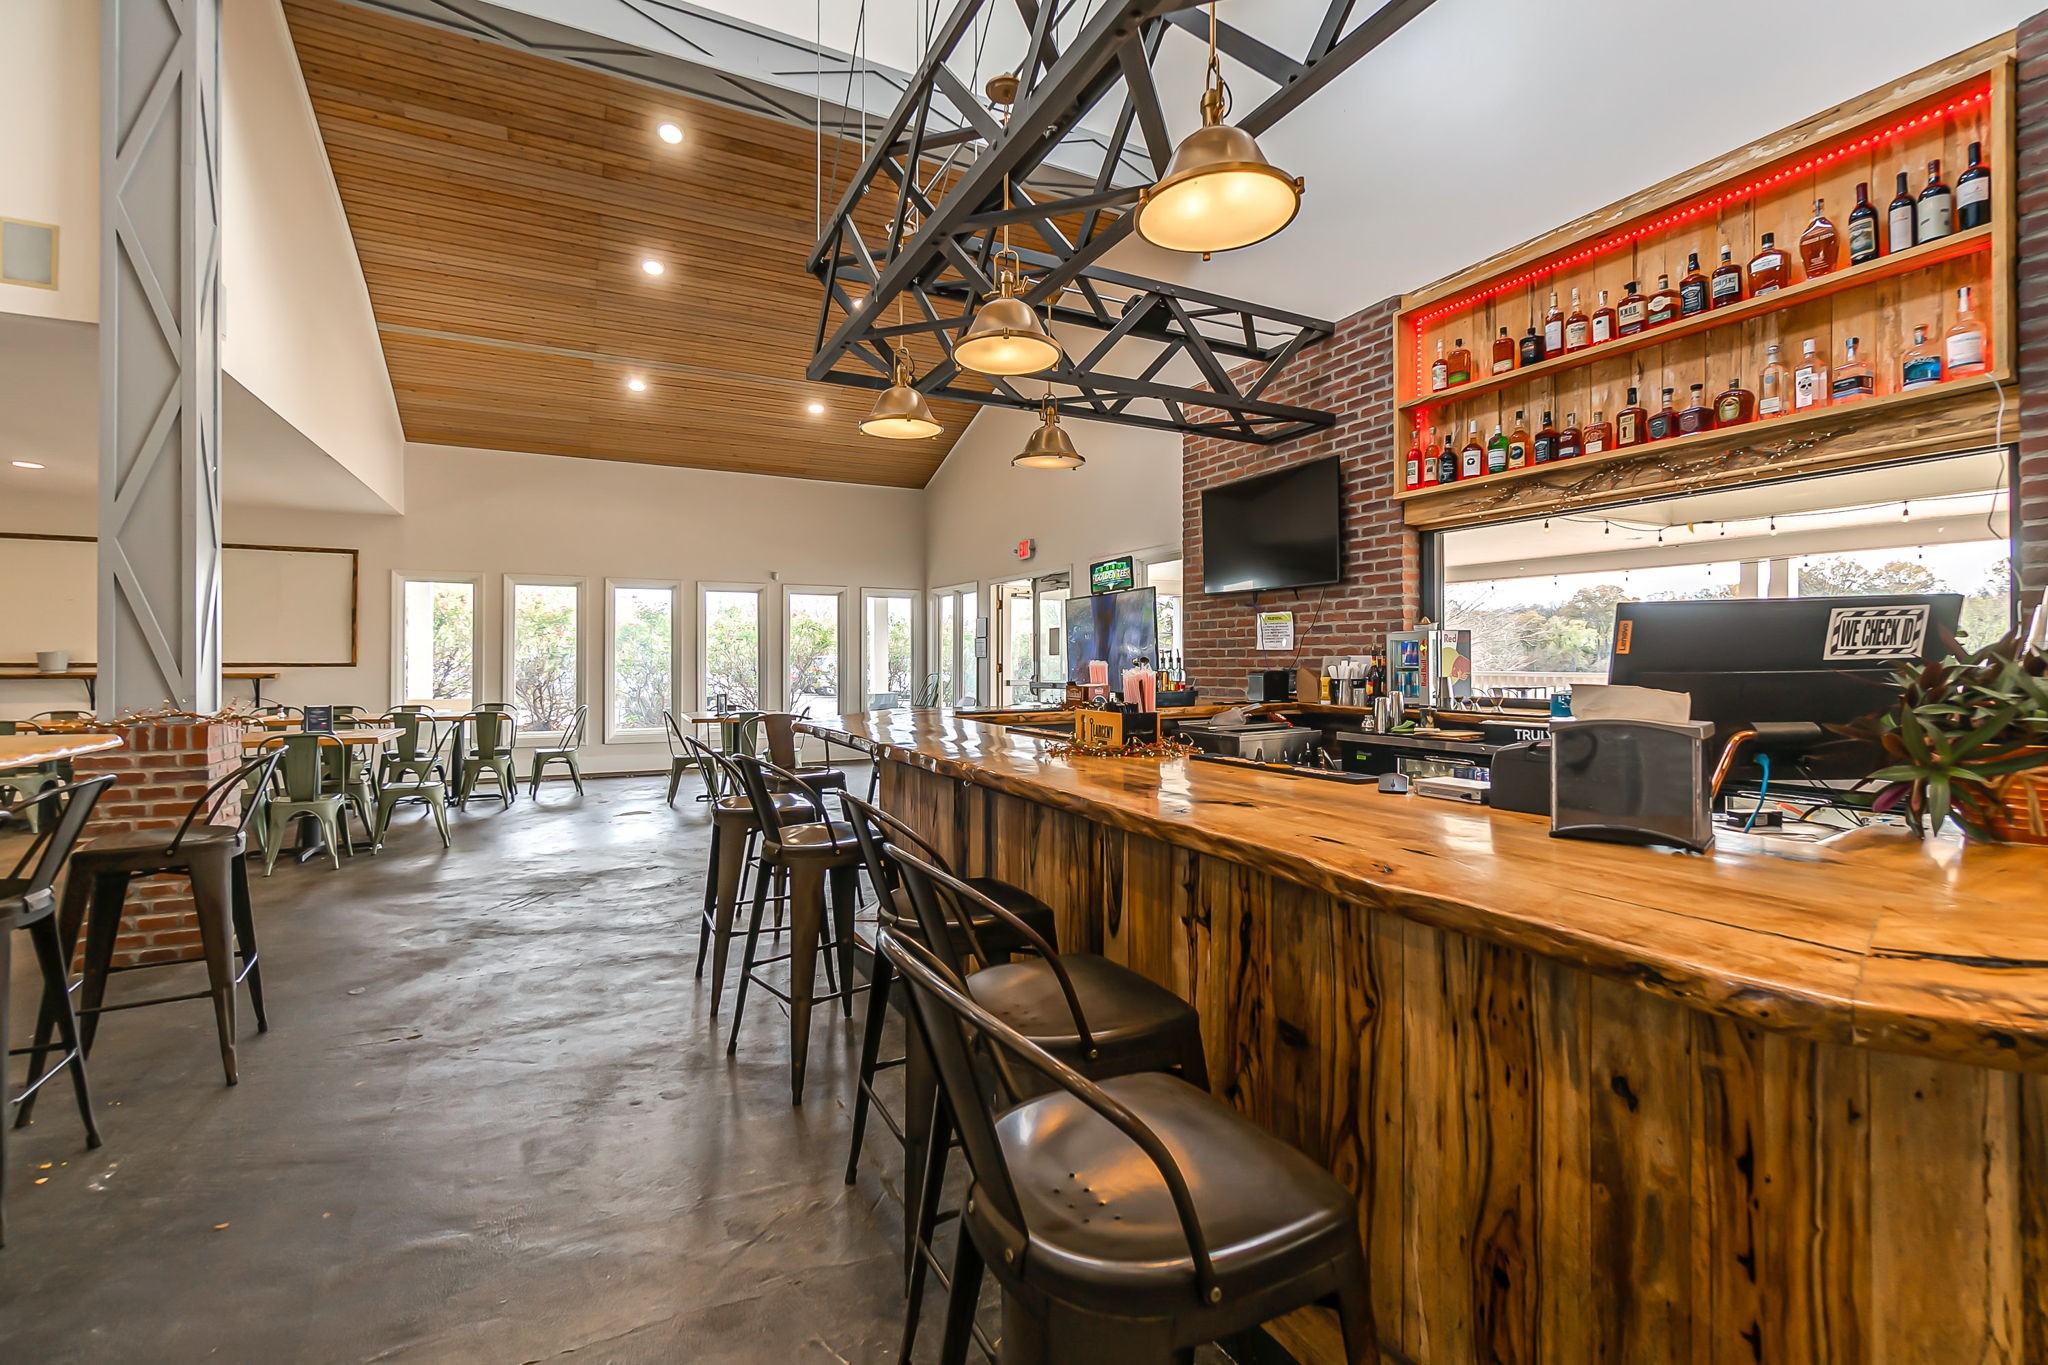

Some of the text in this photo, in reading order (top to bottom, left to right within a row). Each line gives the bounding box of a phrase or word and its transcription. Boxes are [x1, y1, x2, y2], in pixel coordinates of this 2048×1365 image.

[1444, 633, 1457, 643] Red
[1619, 623, 1629, 651] Lenovo
[1840, 618, 1914, 647] WE CHECK ID
